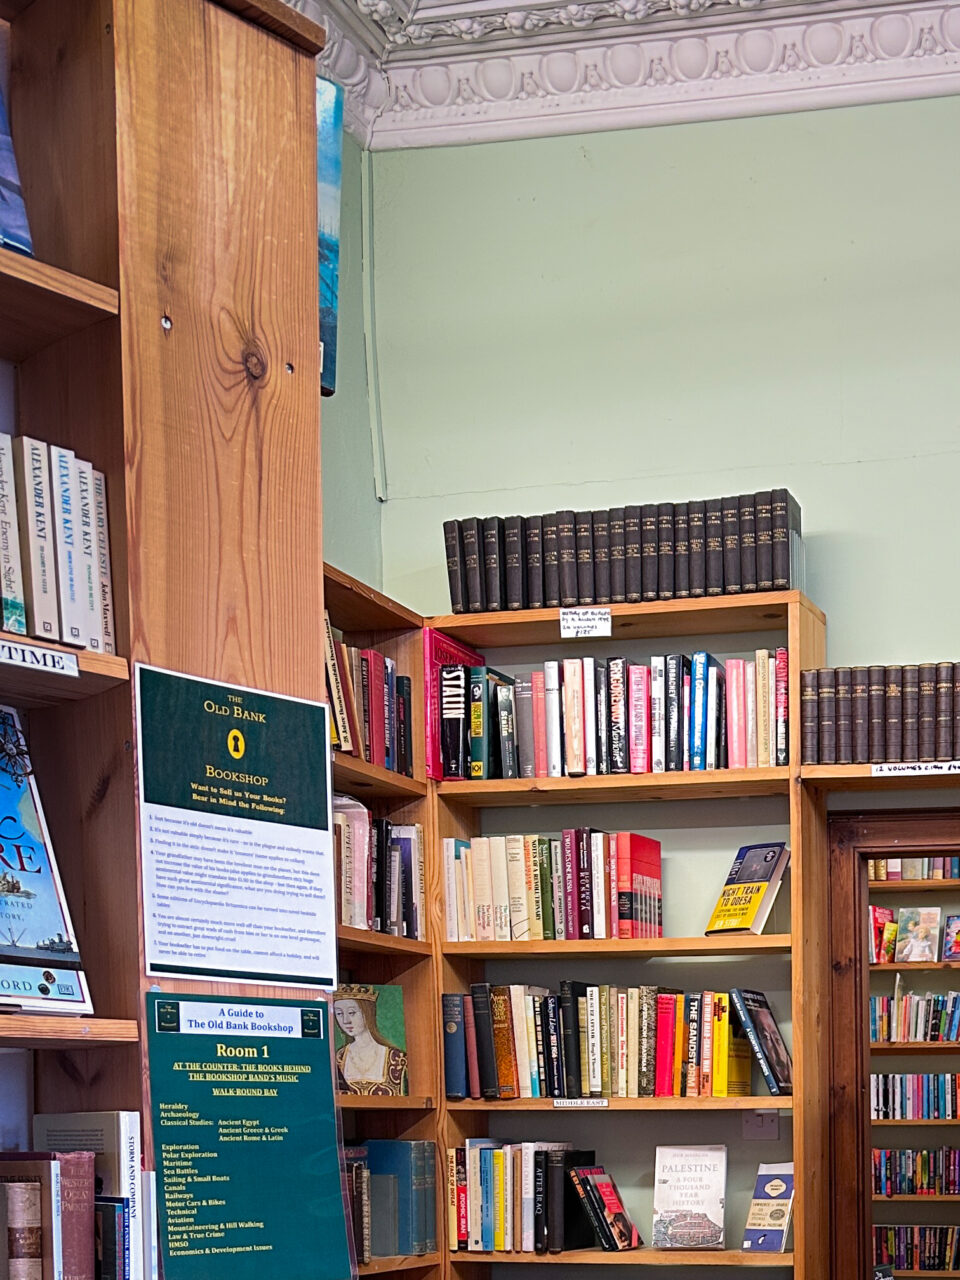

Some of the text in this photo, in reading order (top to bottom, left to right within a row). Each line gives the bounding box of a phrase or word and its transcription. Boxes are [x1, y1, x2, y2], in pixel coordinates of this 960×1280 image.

[31, 444, 46, 541] ALEXANDER KENT
[58, 451, 74, 546] ALEXANDER KENT
[227, 695, 243, 704] THE
[442, 670, 465, 718] STALIN
[191, 782, 209, 792] Want
[220, 786, 233, 797] Sell
[244, 792, 261, 800] Your
[263, 794, 286, 804] Books?
[192, 793, 285, 815] Bear in Mind the Following:
[721, 886, 761, 897] NIGHT TRAIN
[721, 896, 752, 907] TO ODESA
[219, 1008, 264, 1019] A Guide to
[187, 1019, 293, 1034] The Old Bank Bookshop
[216, 1044, 269, 1058] Room 1
[688, 1022, 697, 1087] SANDSTORM
[182, 1151, 218, 1159] Exploration
[163, 1159, 192, 1167] Maritime
[662, 1164, 719, 1172] PALESTINE
[129, 1182, 137, 1219] COMPANY
[165, 1192, 193, 1200] Railways
